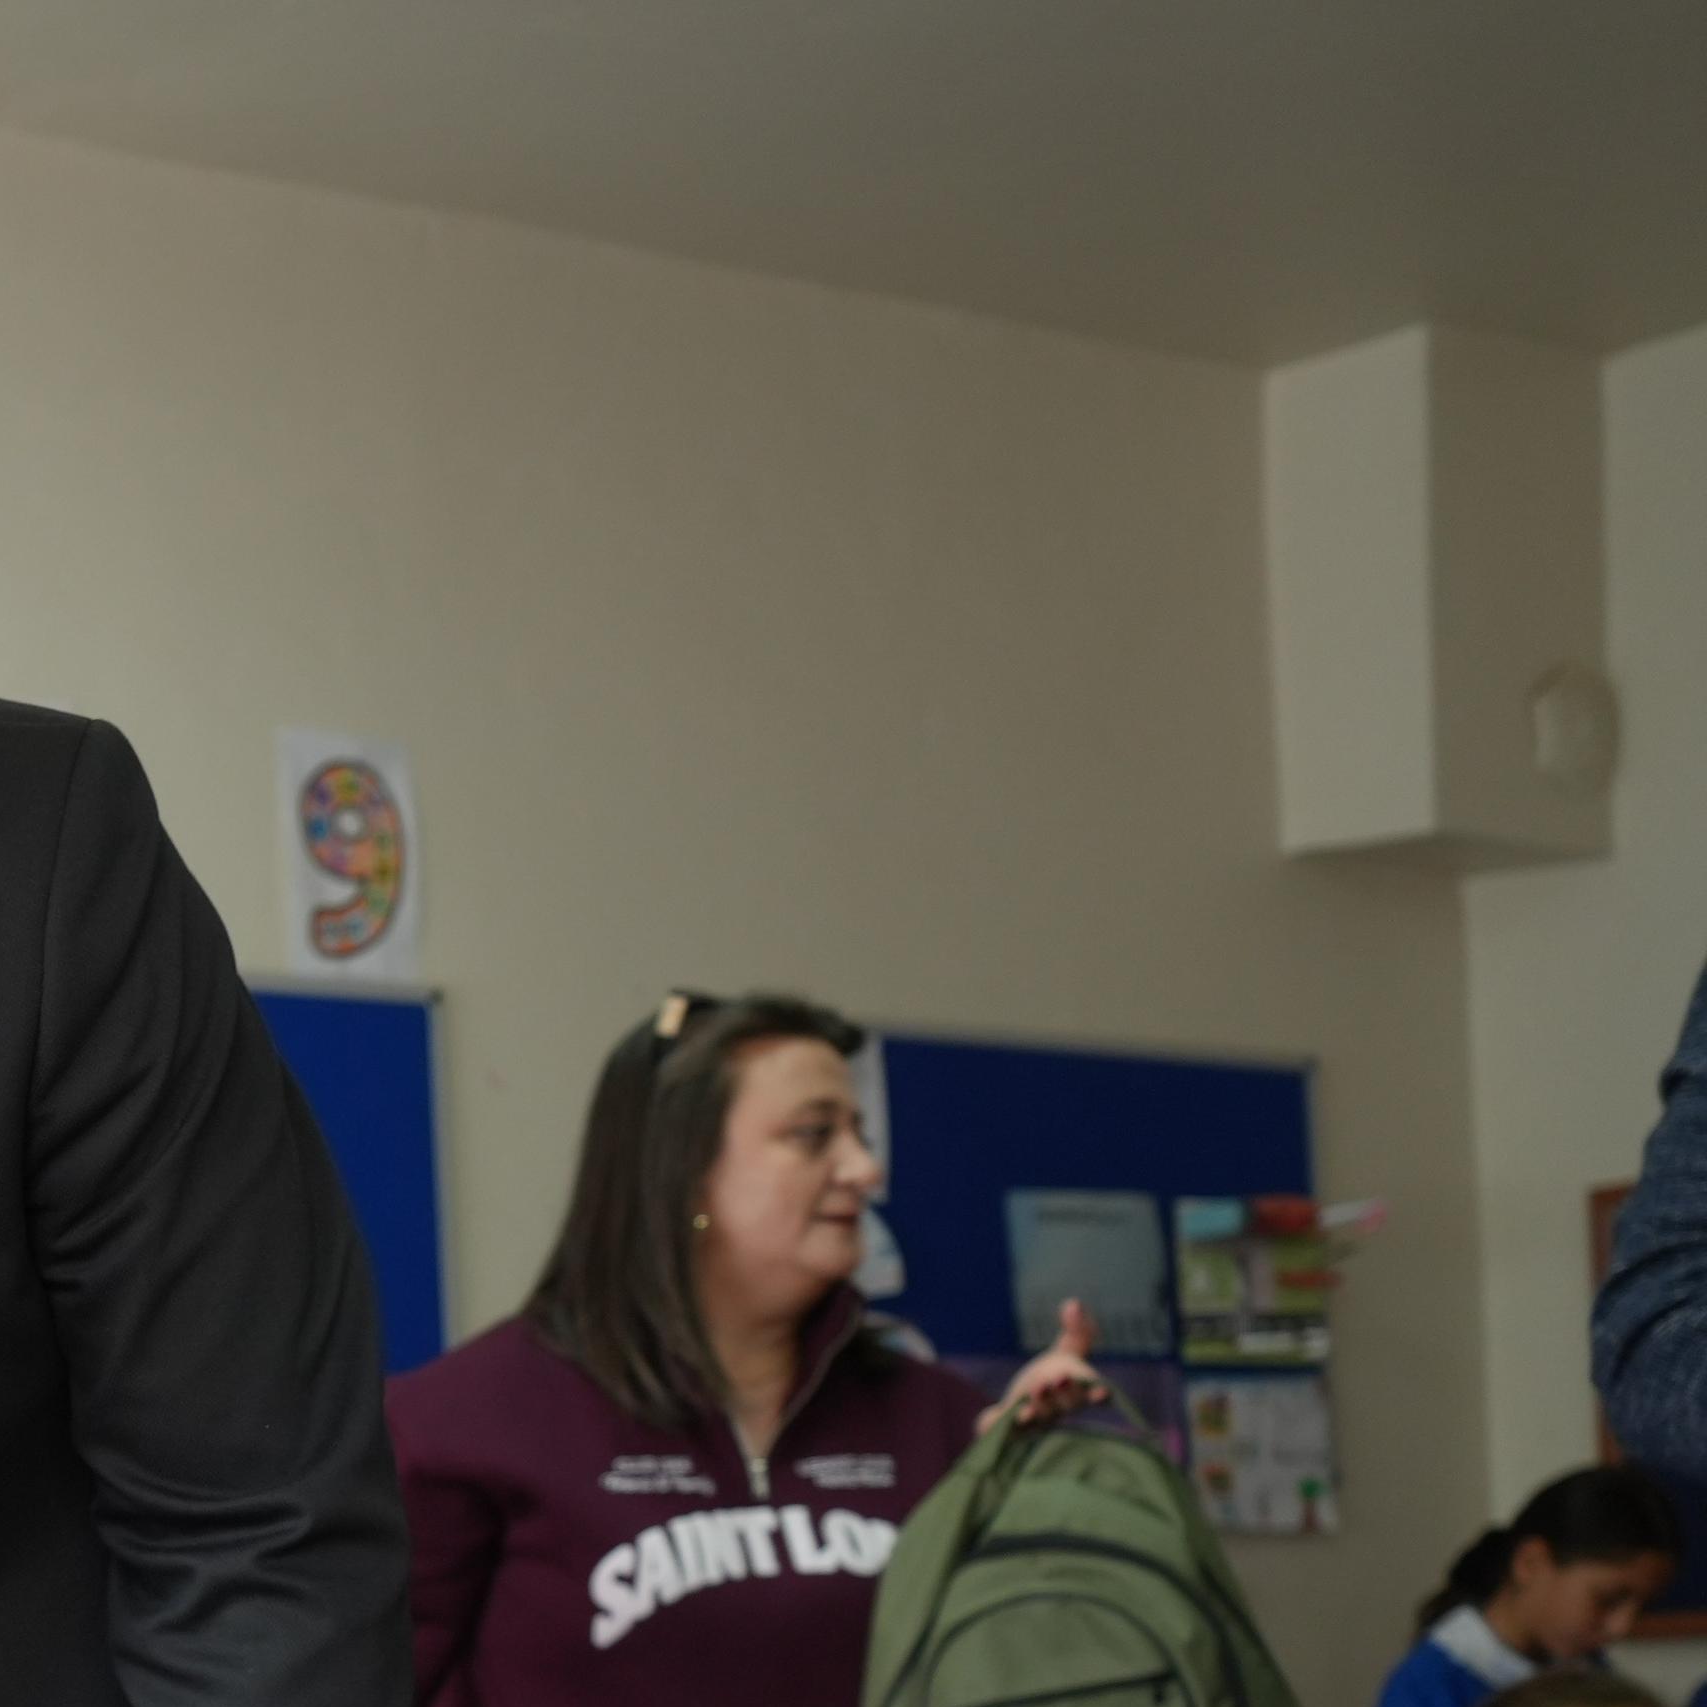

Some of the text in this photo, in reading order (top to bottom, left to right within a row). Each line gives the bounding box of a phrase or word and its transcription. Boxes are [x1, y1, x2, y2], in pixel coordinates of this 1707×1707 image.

[296, 758, 407, 960] 9
[589, 1503, 898, 1649] SAINT LO
